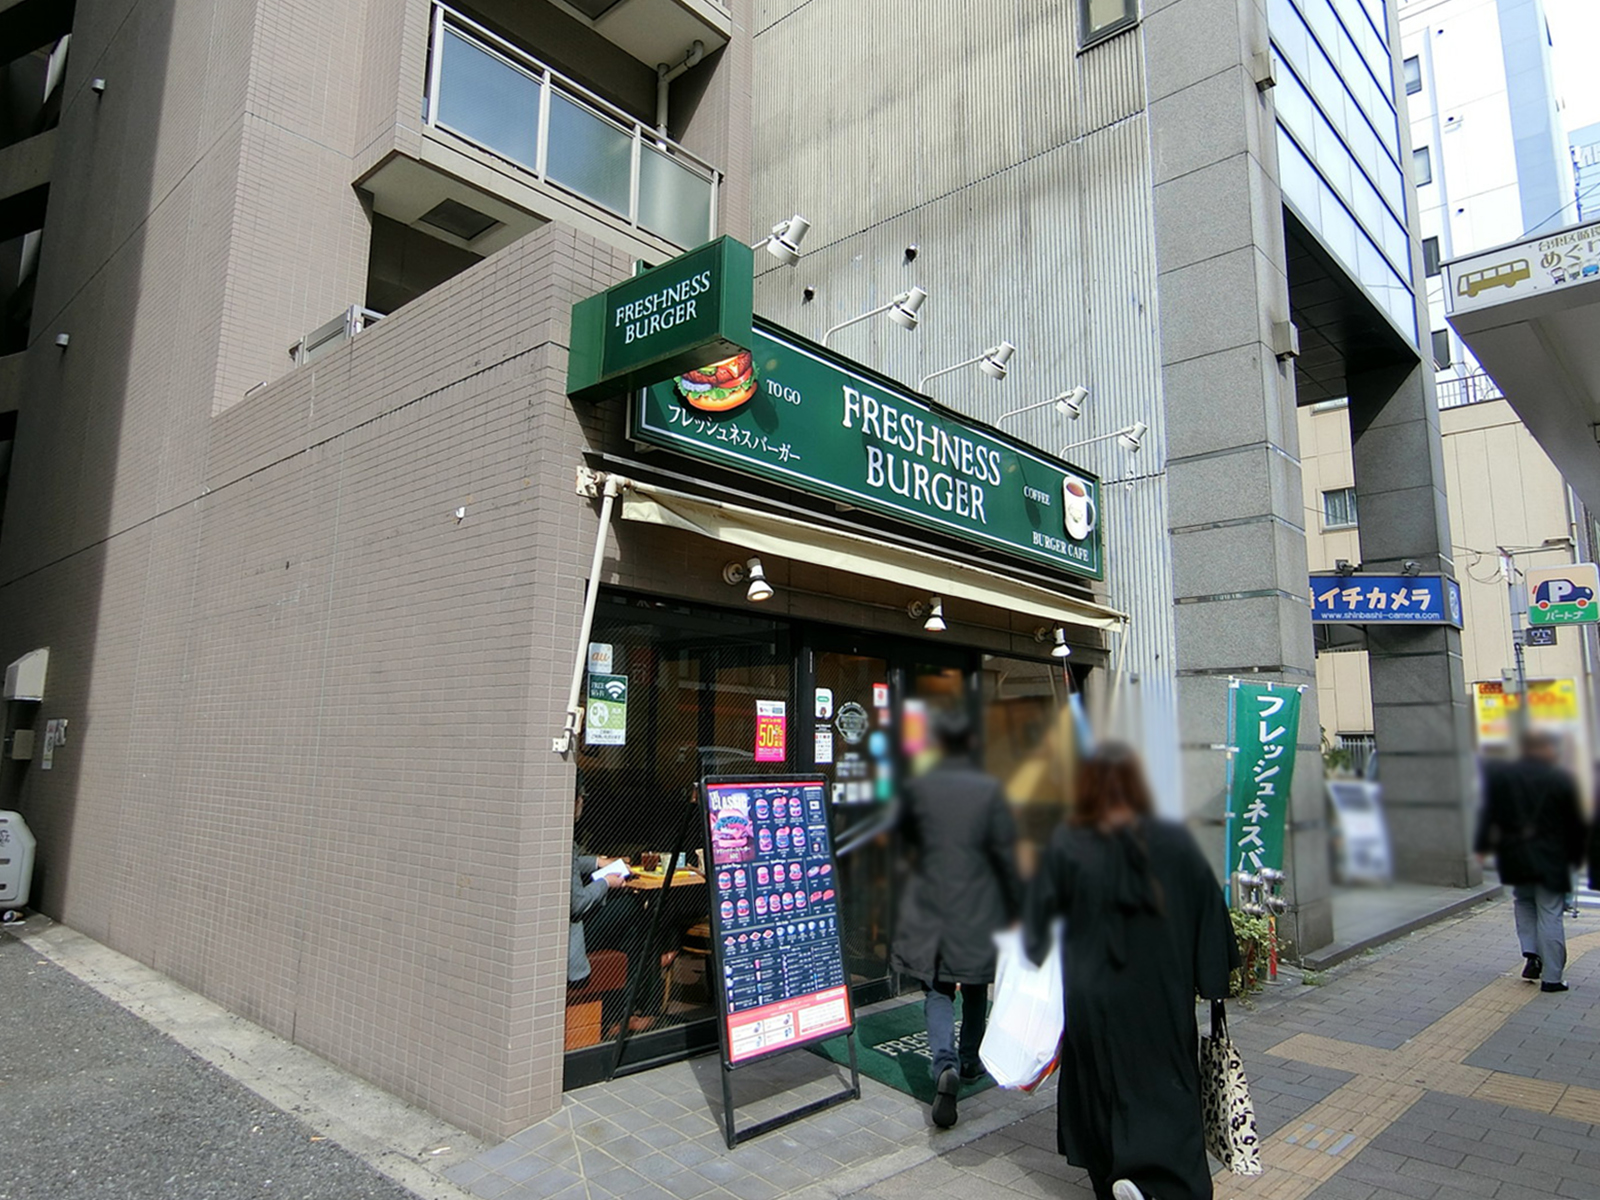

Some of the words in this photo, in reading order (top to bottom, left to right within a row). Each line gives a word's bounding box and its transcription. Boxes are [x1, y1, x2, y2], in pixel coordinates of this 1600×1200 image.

[614, 270, 711, 328] FRESHNESS
[624, 299, 698, 345] BURGER
[766, 378, 782, 398] TO
[783, 385, 802, 406] GO
[667, 403, 801, 463] フレッシュネスバーガー
[842, 384, 1001, 487] FRESHNESS
[865, 444, 987, 525] BURGER
[1023, 484, 1051, 506] COFFEE
[1032, 530, 1068, 556] BURGER
[1067, 543, 1090, 563] CAFE
[1321, 611, 1440, 620] www.shinbashi-camera.com
[1531, 628, 1552, 645] 空
